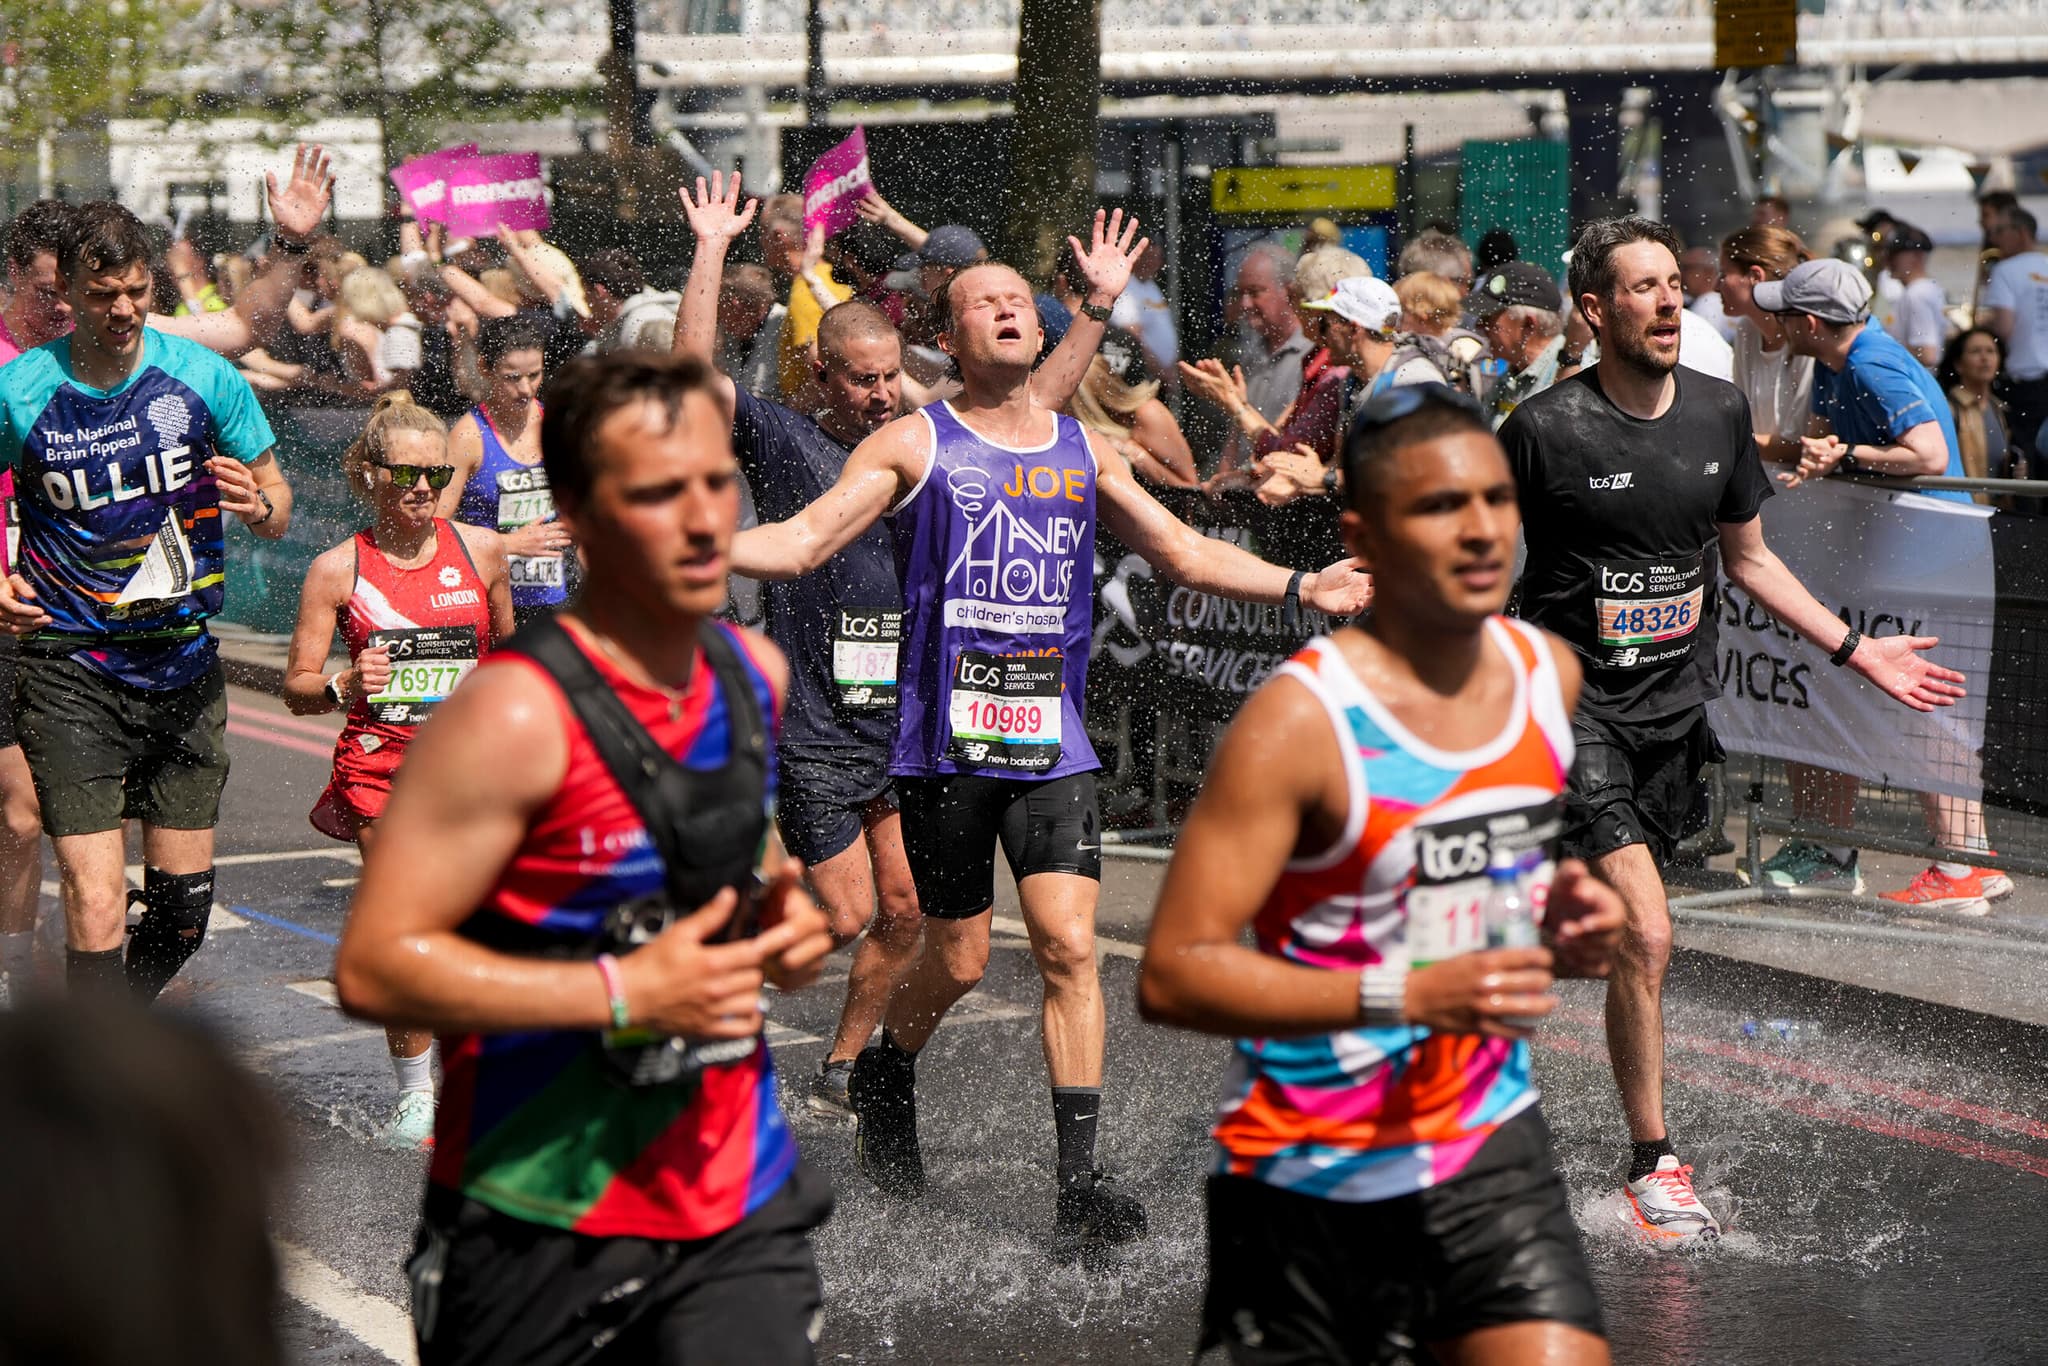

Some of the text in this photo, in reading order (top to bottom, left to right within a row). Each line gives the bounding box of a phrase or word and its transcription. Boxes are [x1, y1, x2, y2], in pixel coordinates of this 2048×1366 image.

[44, 415, 138, 444] The National
[46, 432, 142, 461] Brain Appeal
[42, 445, 192, 511] OLLIE
[1003, 464, 1087, 503] JOE
[1589, 475, 1611, 490] tcs
[510, 560, 559, 583] CLAIRE
[1601, 566, 1645, 593] tcs
[1649, 565, 1676, 574] TATA
[1649, 566, 1701, 584] CONSULTANCY
[1649, 581, 1686, 593] SERVICES
[430, 589, 480, 609] LONDON
[841, 612, 879, 637] tcs
[956, 605, 1024, 626] children's
[1612, 601, 1692, 634] 48326
[416, 632, 441, 640] TATA
[416, 639, 470, 649] CONSULTANCY
[416, 647, 450, 655] SERVICES
[1639, 654, 1660, 664] new
[854, 651, 897, 677] 187
[961, 657, 1001, 687] tcs
[1006, 664, 1027, 672] TATA
[387, 666, 460, 693] 76977
[1004, 682, 1035, 690] SERVICES
[1005, 672, 1055, 681] CONSULTANCY
[967, 700, 1043, 734] 10989
[988, 755, 1050, 766] new balance
[1420, 829, 1489, 881] tcs
